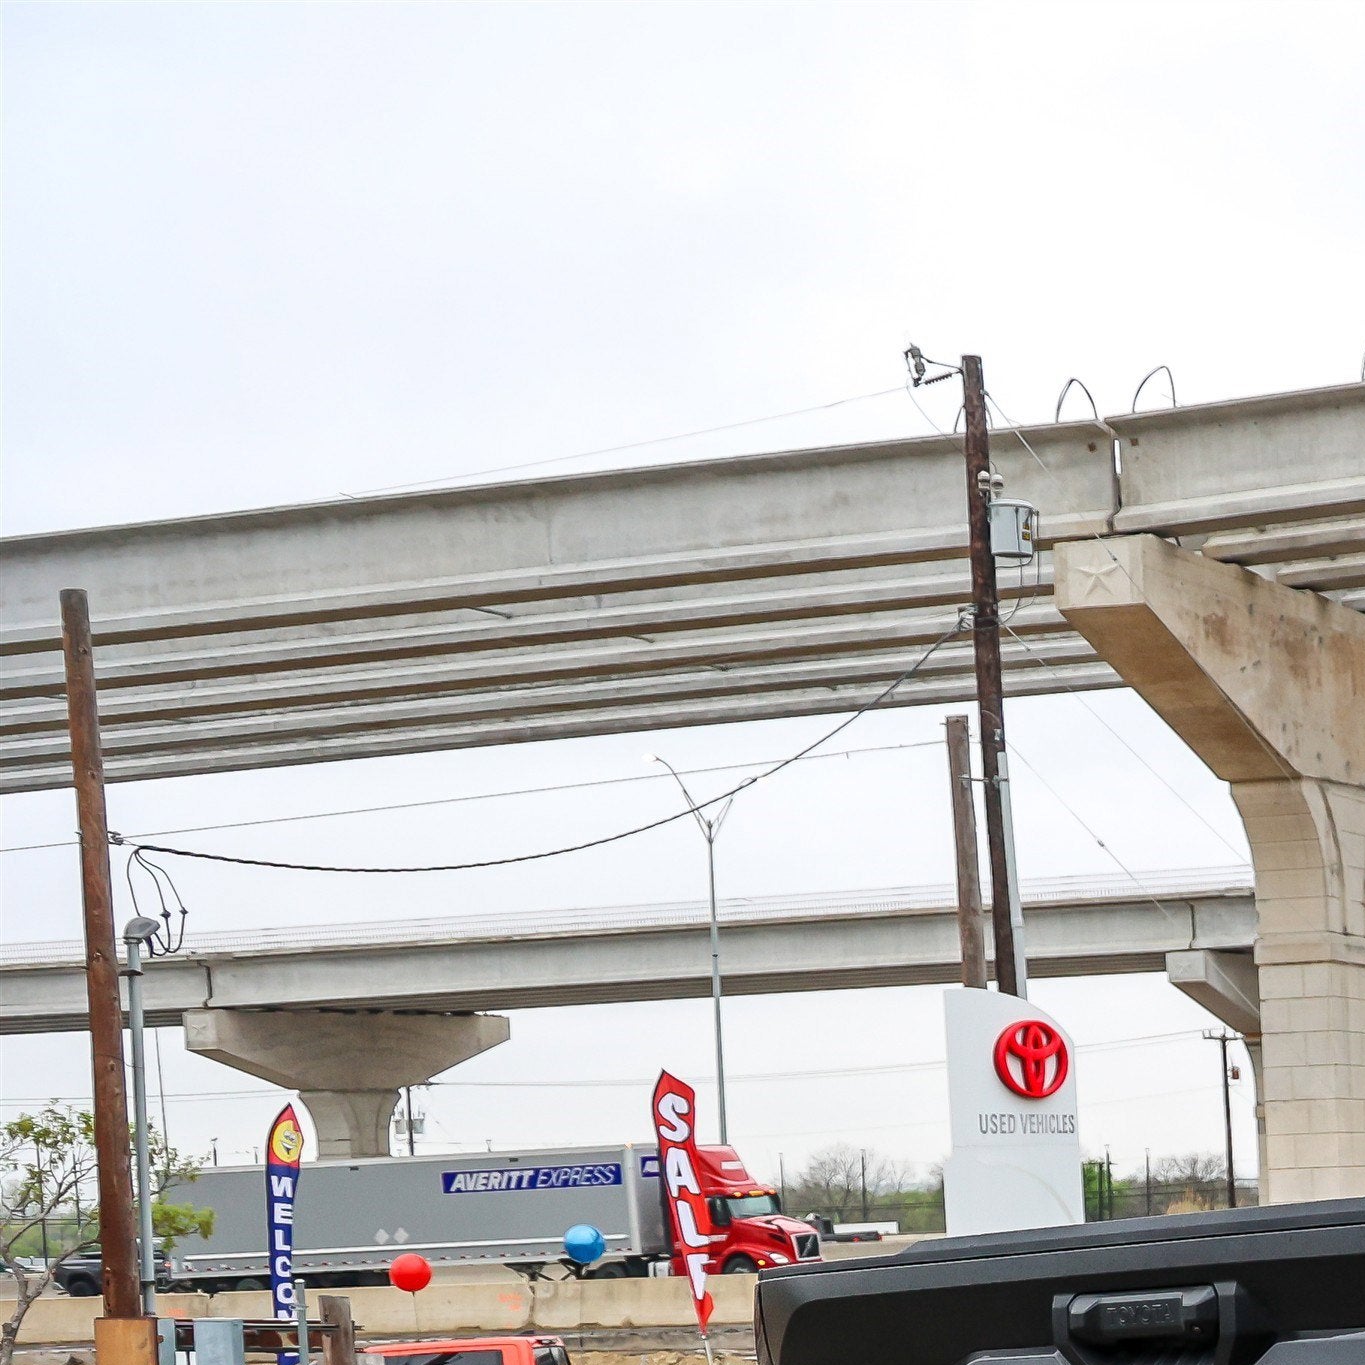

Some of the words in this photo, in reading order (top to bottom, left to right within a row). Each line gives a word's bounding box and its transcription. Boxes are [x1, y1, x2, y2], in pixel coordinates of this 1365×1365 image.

[978, 1113, 1016, 1134] USED
[1020, 1113, 1075, 1134] VEHICLES
[449, 1169, 534, 1192] AVERITT
[536, 1165, 617, 1188] EXPRESS
[1106, 1303, 1175, 1326] TOYOTA
